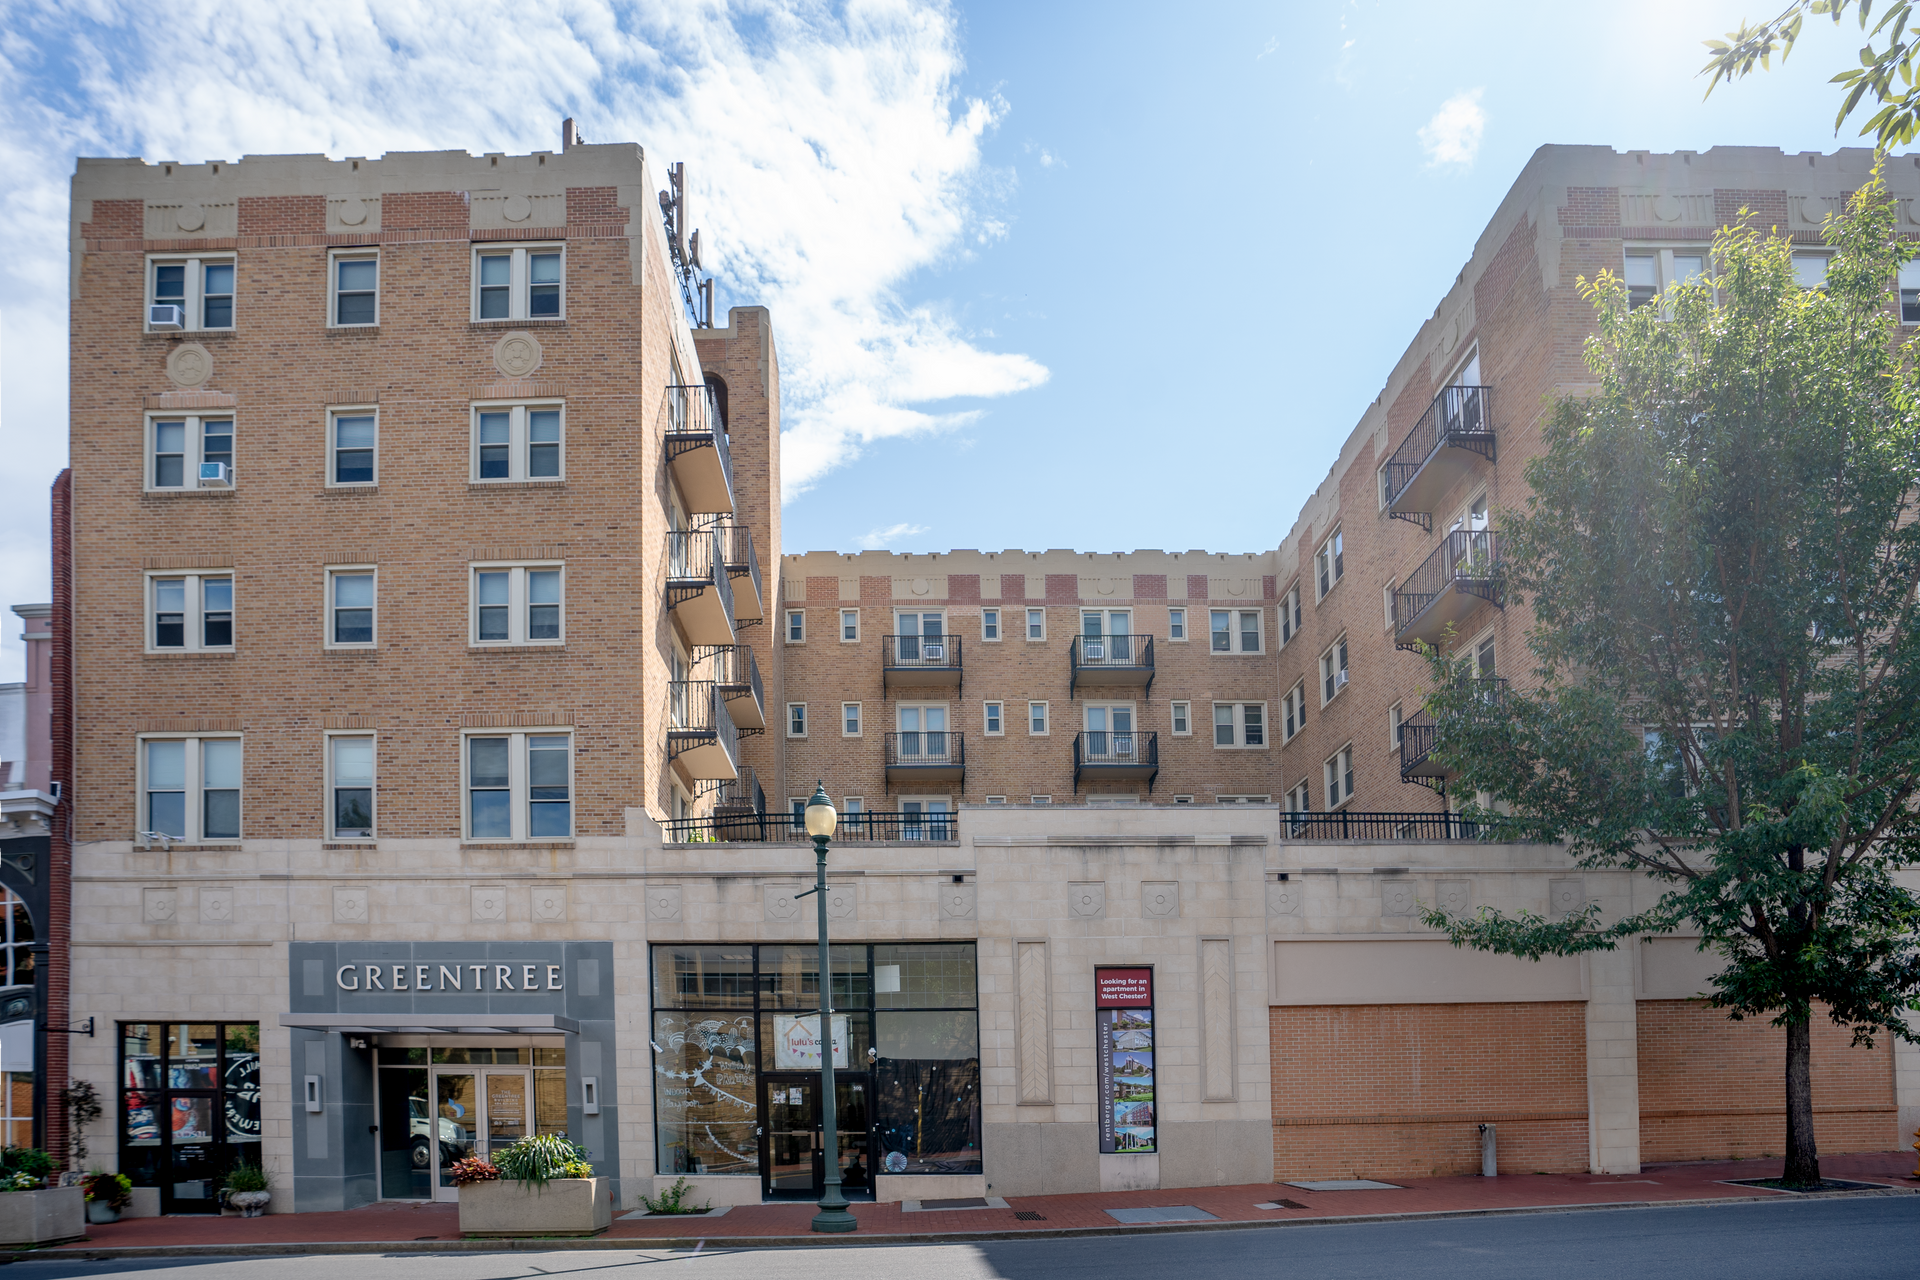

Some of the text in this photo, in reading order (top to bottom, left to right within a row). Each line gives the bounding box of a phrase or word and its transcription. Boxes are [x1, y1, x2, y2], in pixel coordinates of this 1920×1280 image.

[336, 964, 563, 991] GREENTREE
[1100, 978, 1127, 986] Looking
[791, 1038, 814, 1046] lulu's
[1102, 1022, 1112, 1141] rentberger.com/westchester
[663, 1087, 692, 1096] INDOOR
